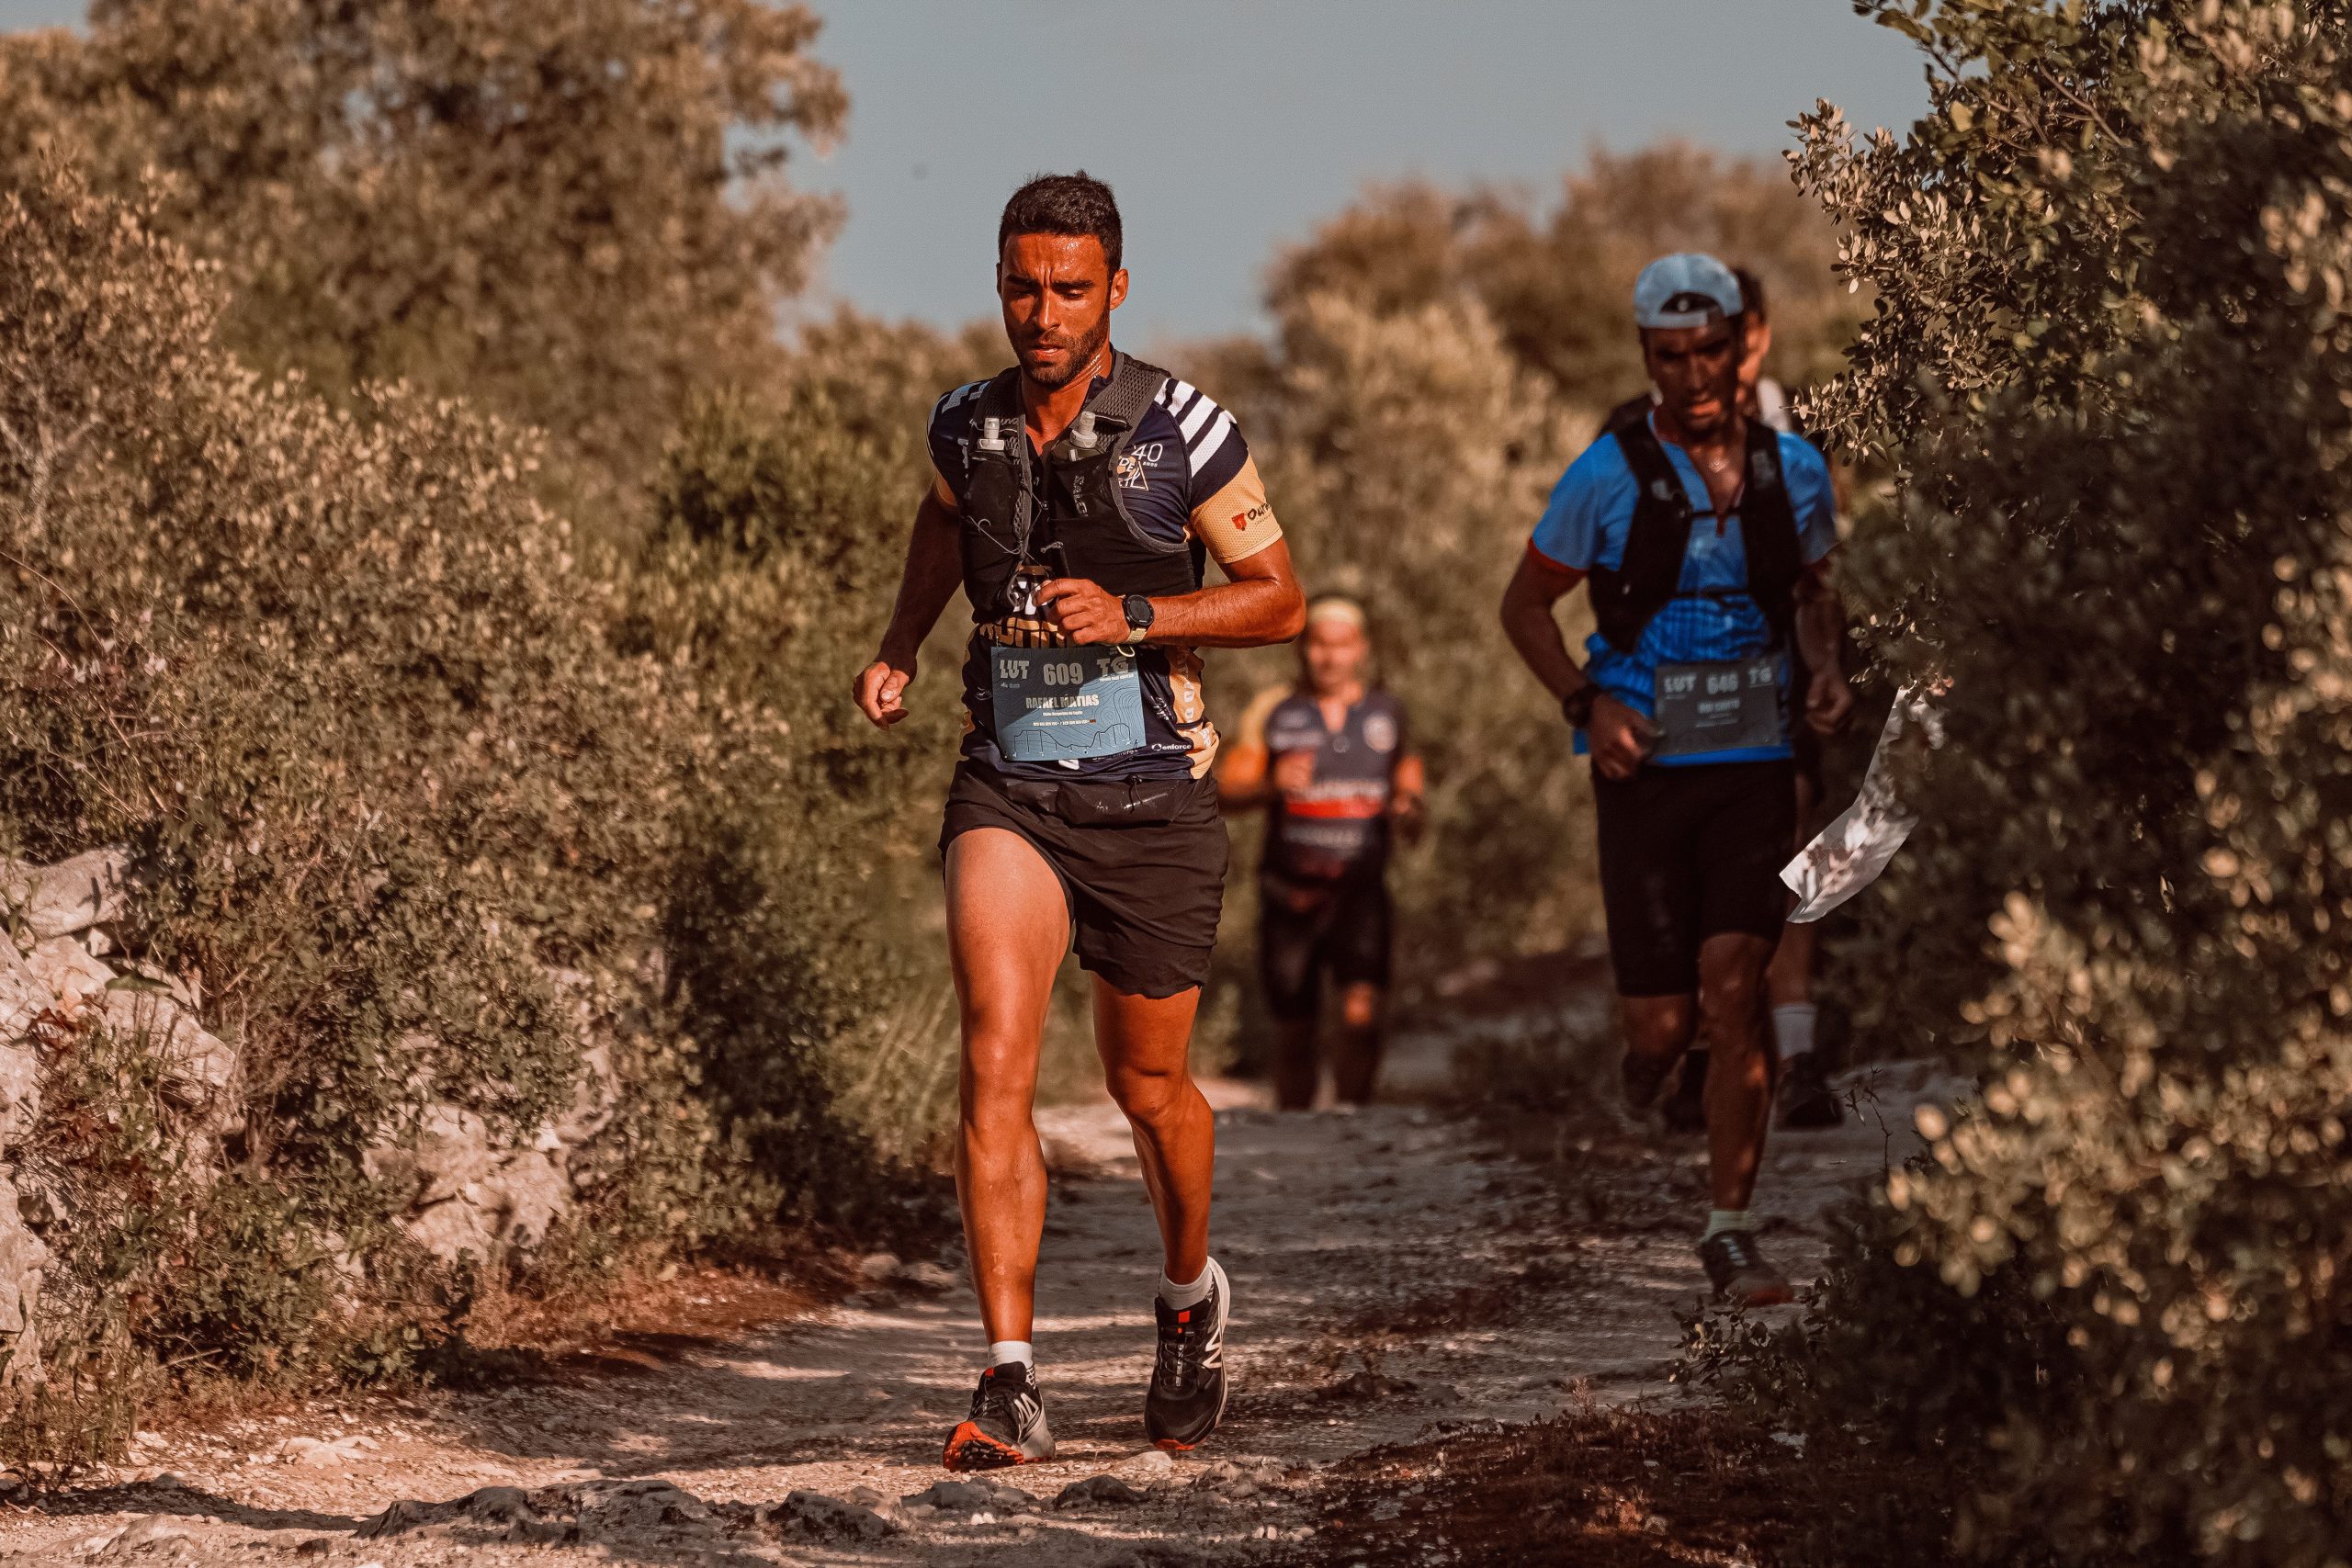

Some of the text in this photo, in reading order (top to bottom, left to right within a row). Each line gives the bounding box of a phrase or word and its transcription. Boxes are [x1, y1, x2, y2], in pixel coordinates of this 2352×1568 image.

[1000, 660, 1029, 680] LUT
[1043, 662, 1083, 686] 609
[1096, 656, 1129, 678] TG
[1025, 694, 1100, 709] RAFAEL MATIAS
